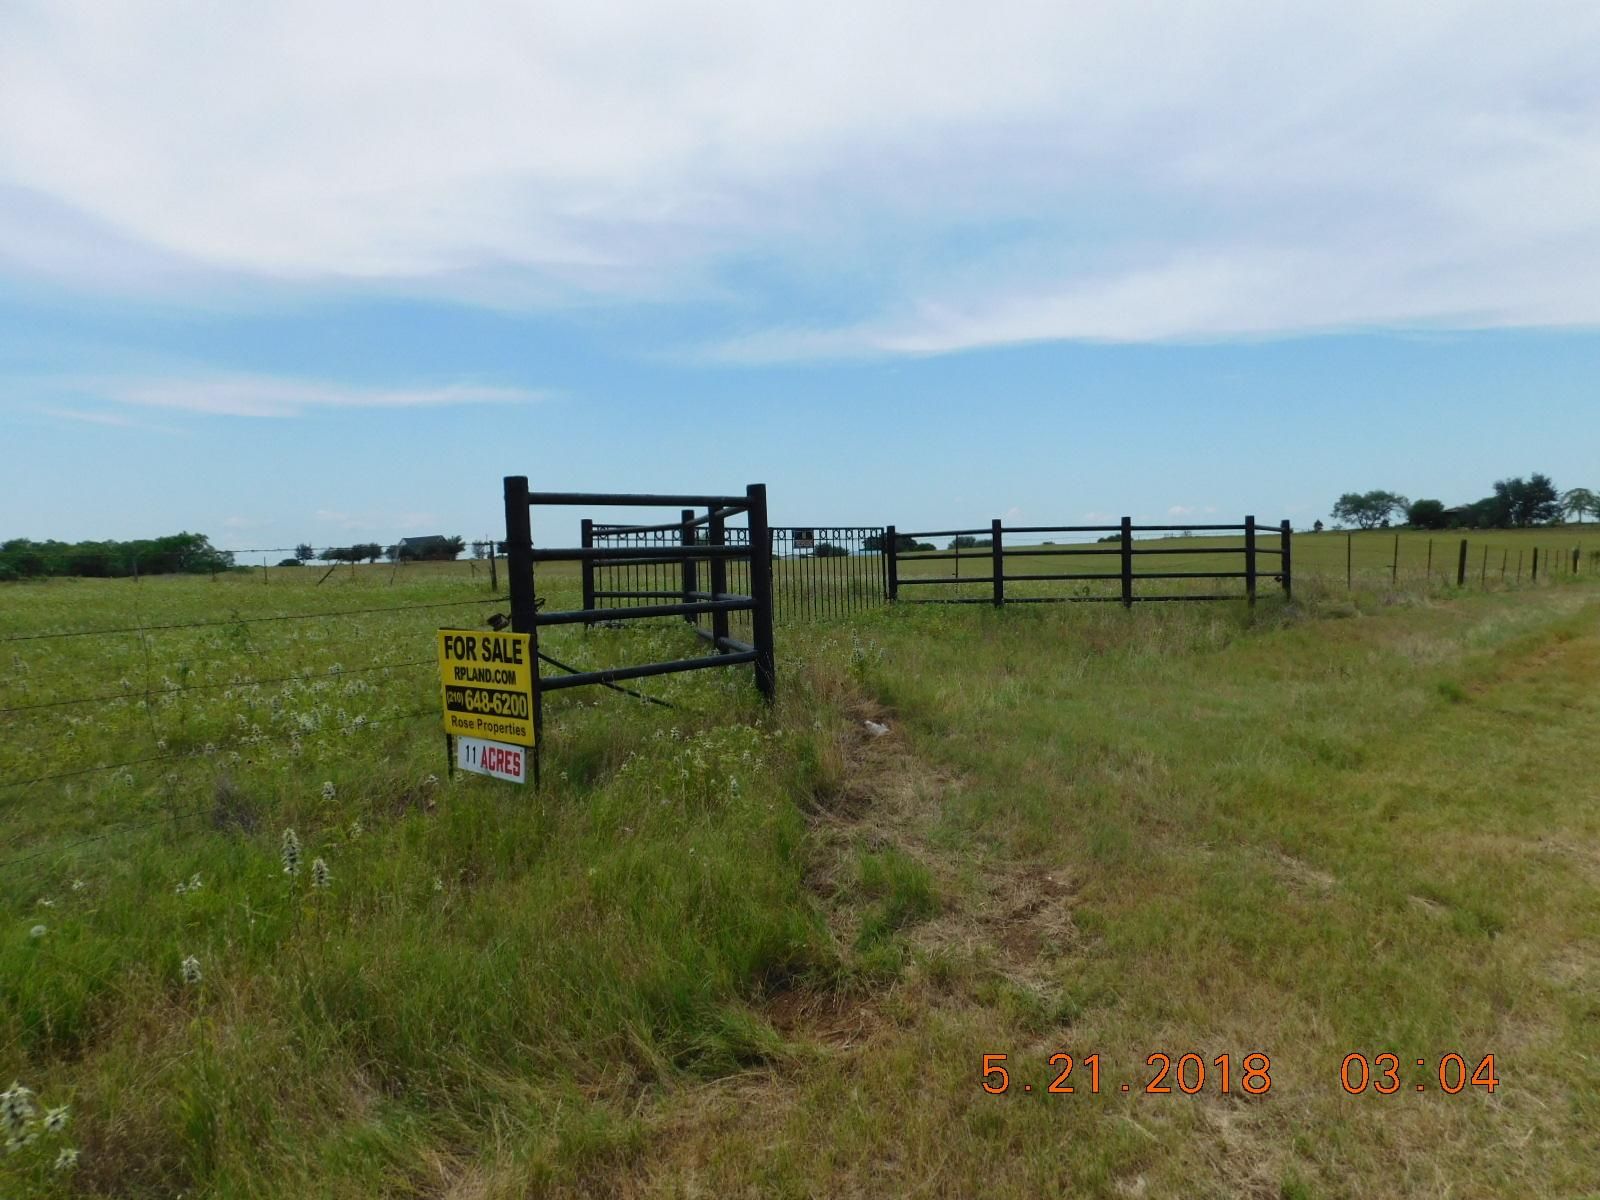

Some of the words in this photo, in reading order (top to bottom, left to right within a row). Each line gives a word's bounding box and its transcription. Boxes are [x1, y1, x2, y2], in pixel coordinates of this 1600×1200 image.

[444, 635, 477, 661] FOR
[482, 637, 523, 665] SALE
[454, 666, 517, 686] RPLAND.COM
[465, 690, 528, 717] 648-6200
[451, 715, 475, 729] Rose
[477, 718, 527, 737] Properties
[480, 745, 521, 777] ACRES
